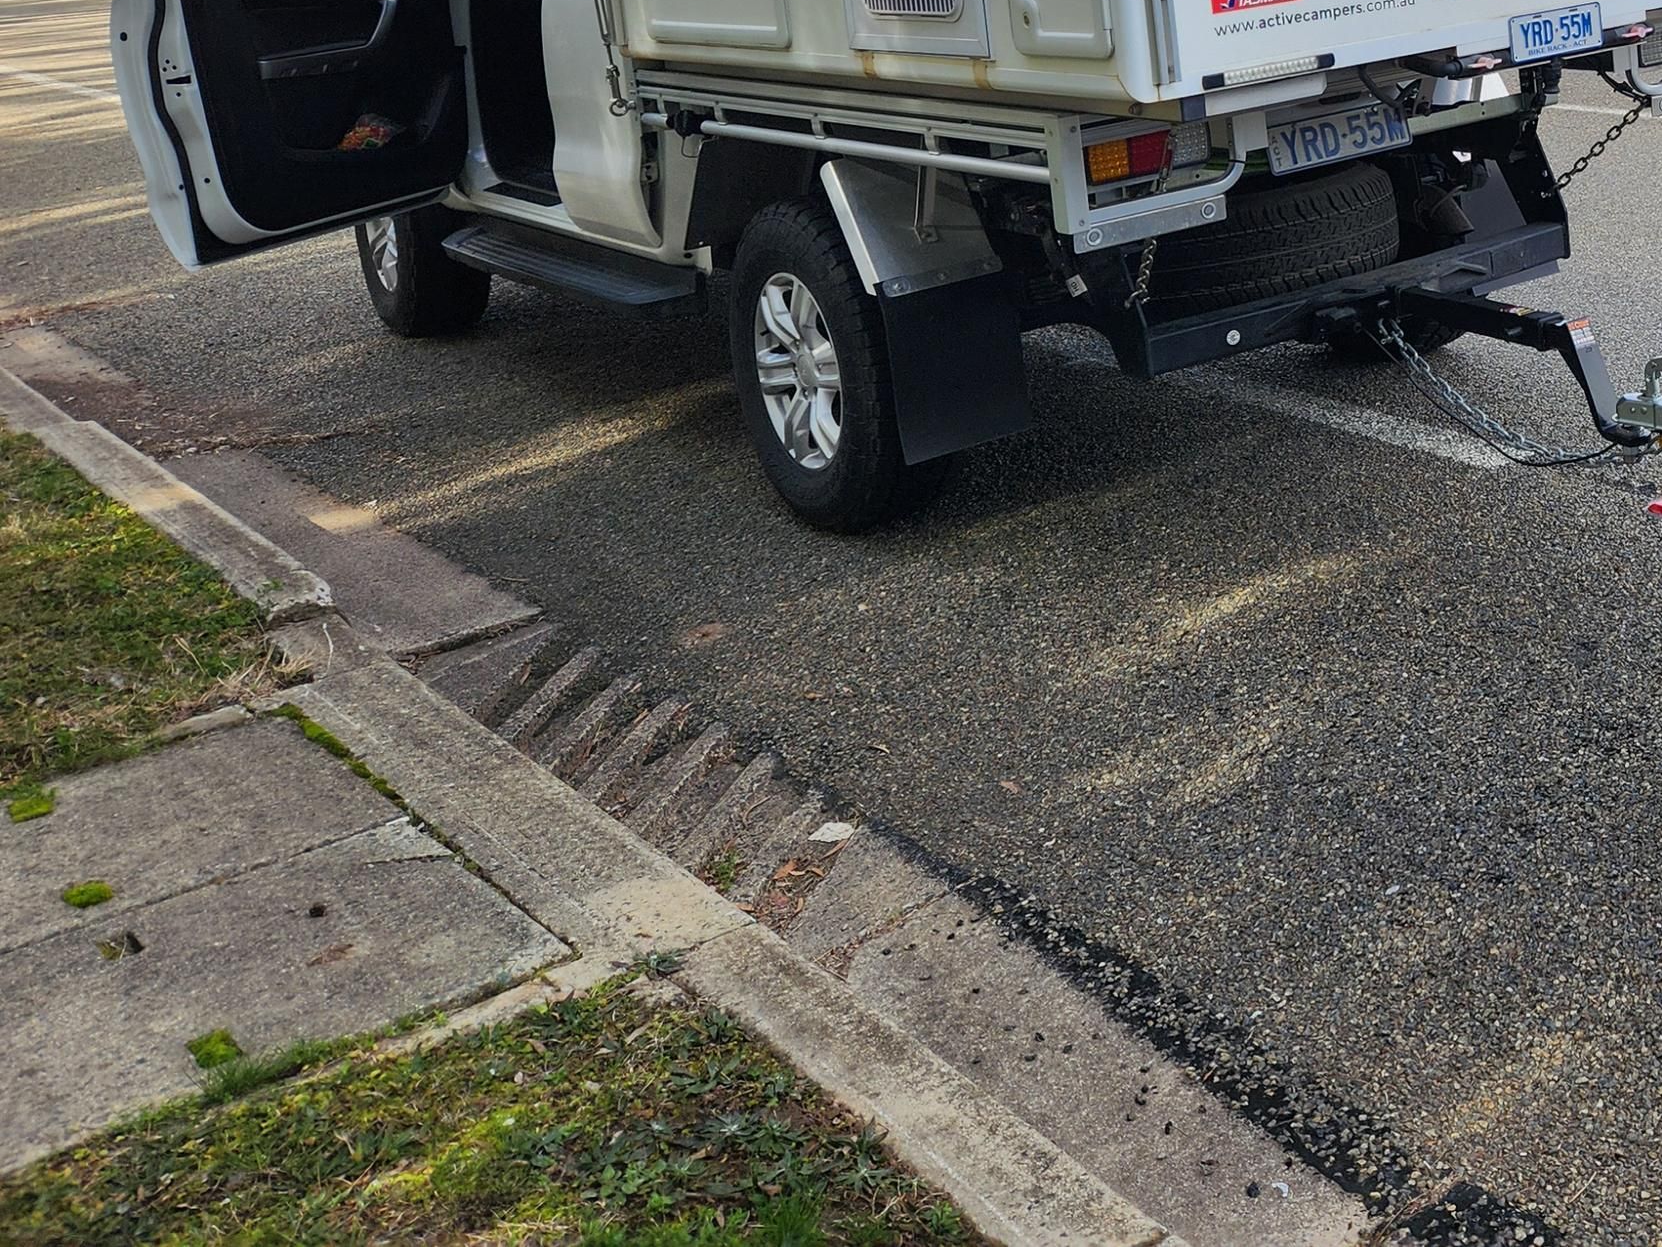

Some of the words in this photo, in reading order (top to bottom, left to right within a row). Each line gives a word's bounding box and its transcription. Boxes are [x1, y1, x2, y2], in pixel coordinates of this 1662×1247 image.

[1528, 47, 1545, 56] BIKE
[1547, 44, 1568, 53] RACK
[1573, 39, 1588, 47] ACT
